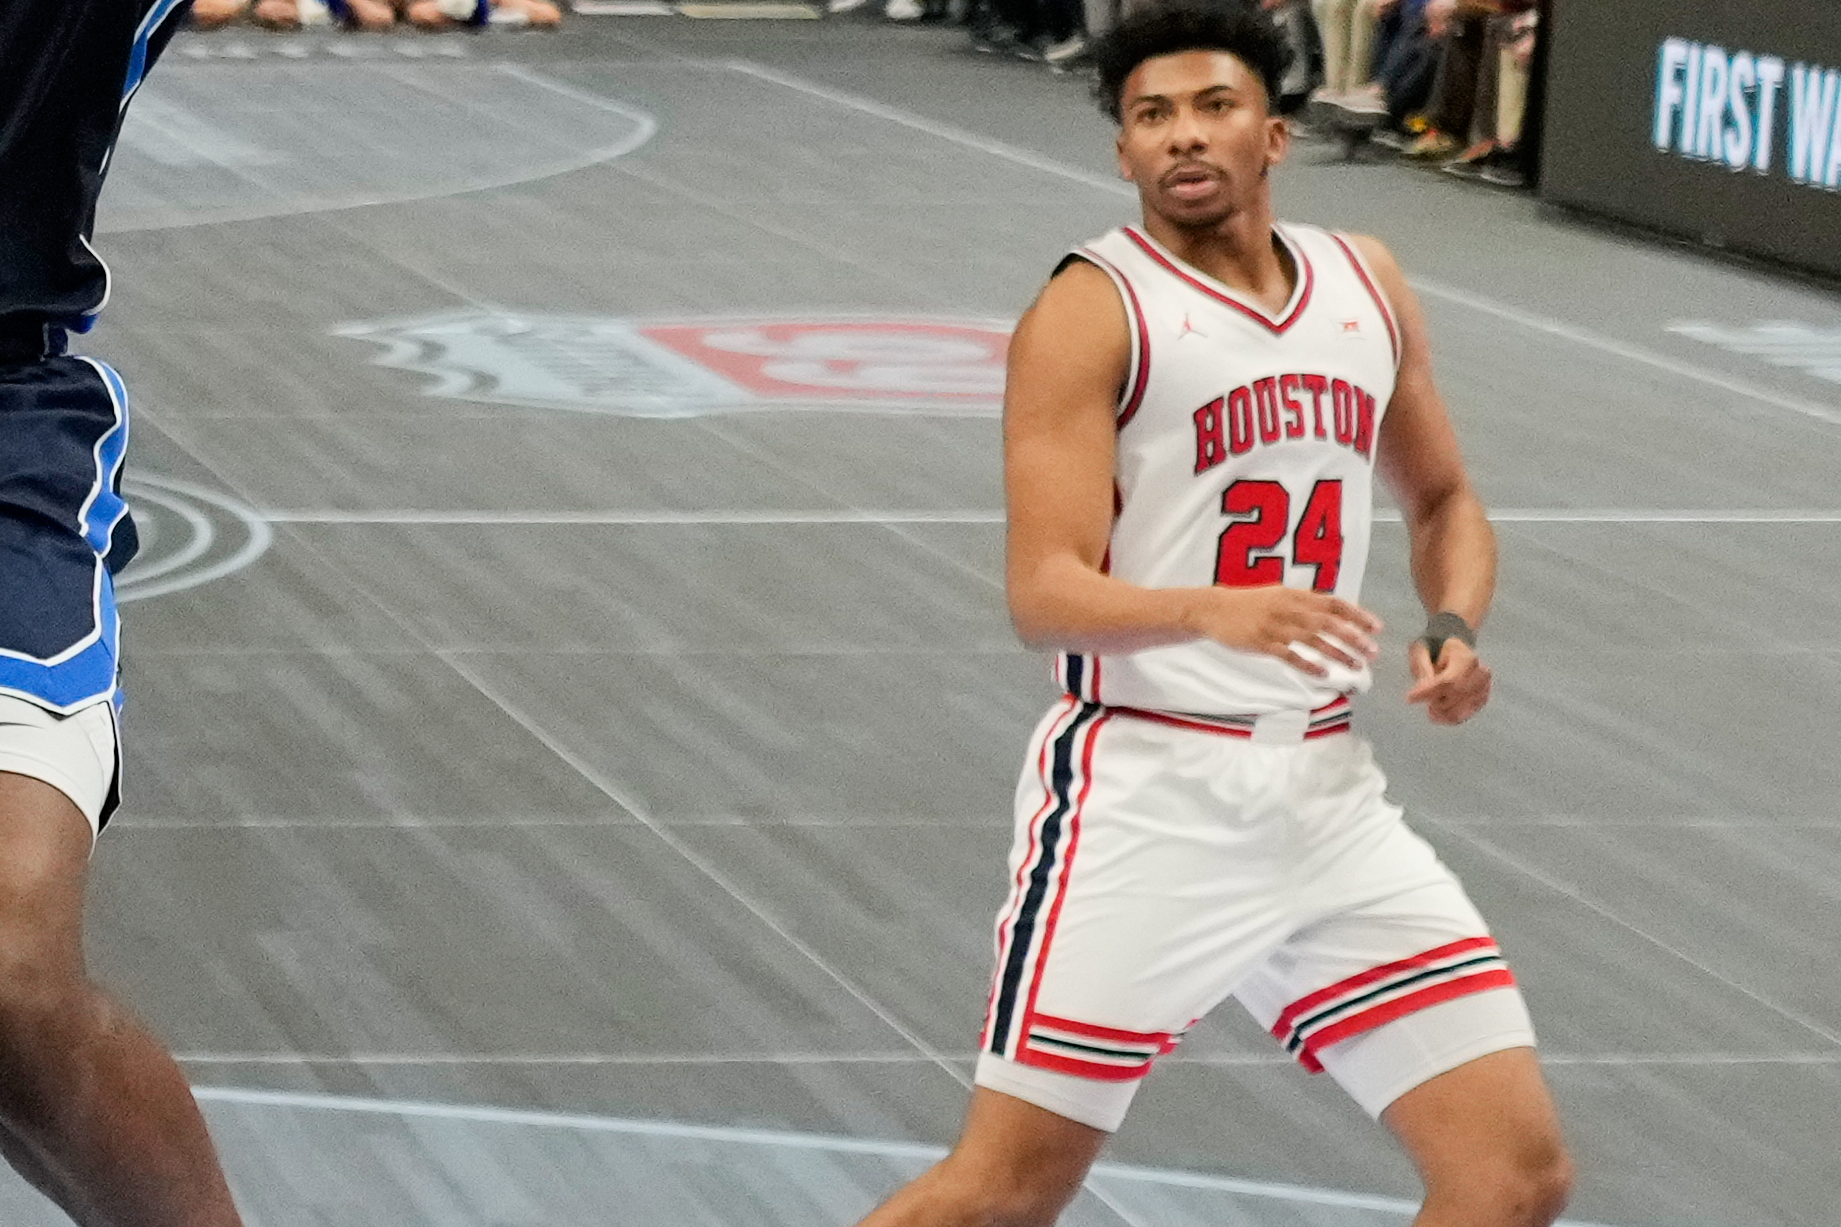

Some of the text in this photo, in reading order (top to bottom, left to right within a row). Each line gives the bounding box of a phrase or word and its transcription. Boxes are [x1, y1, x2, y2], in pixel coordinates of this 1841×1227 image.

[1653, 36, 1785, 173] FIRST
[1192, 373, 1376, 476] HOUSTON
[1213, 478, 1344, 593] 24
